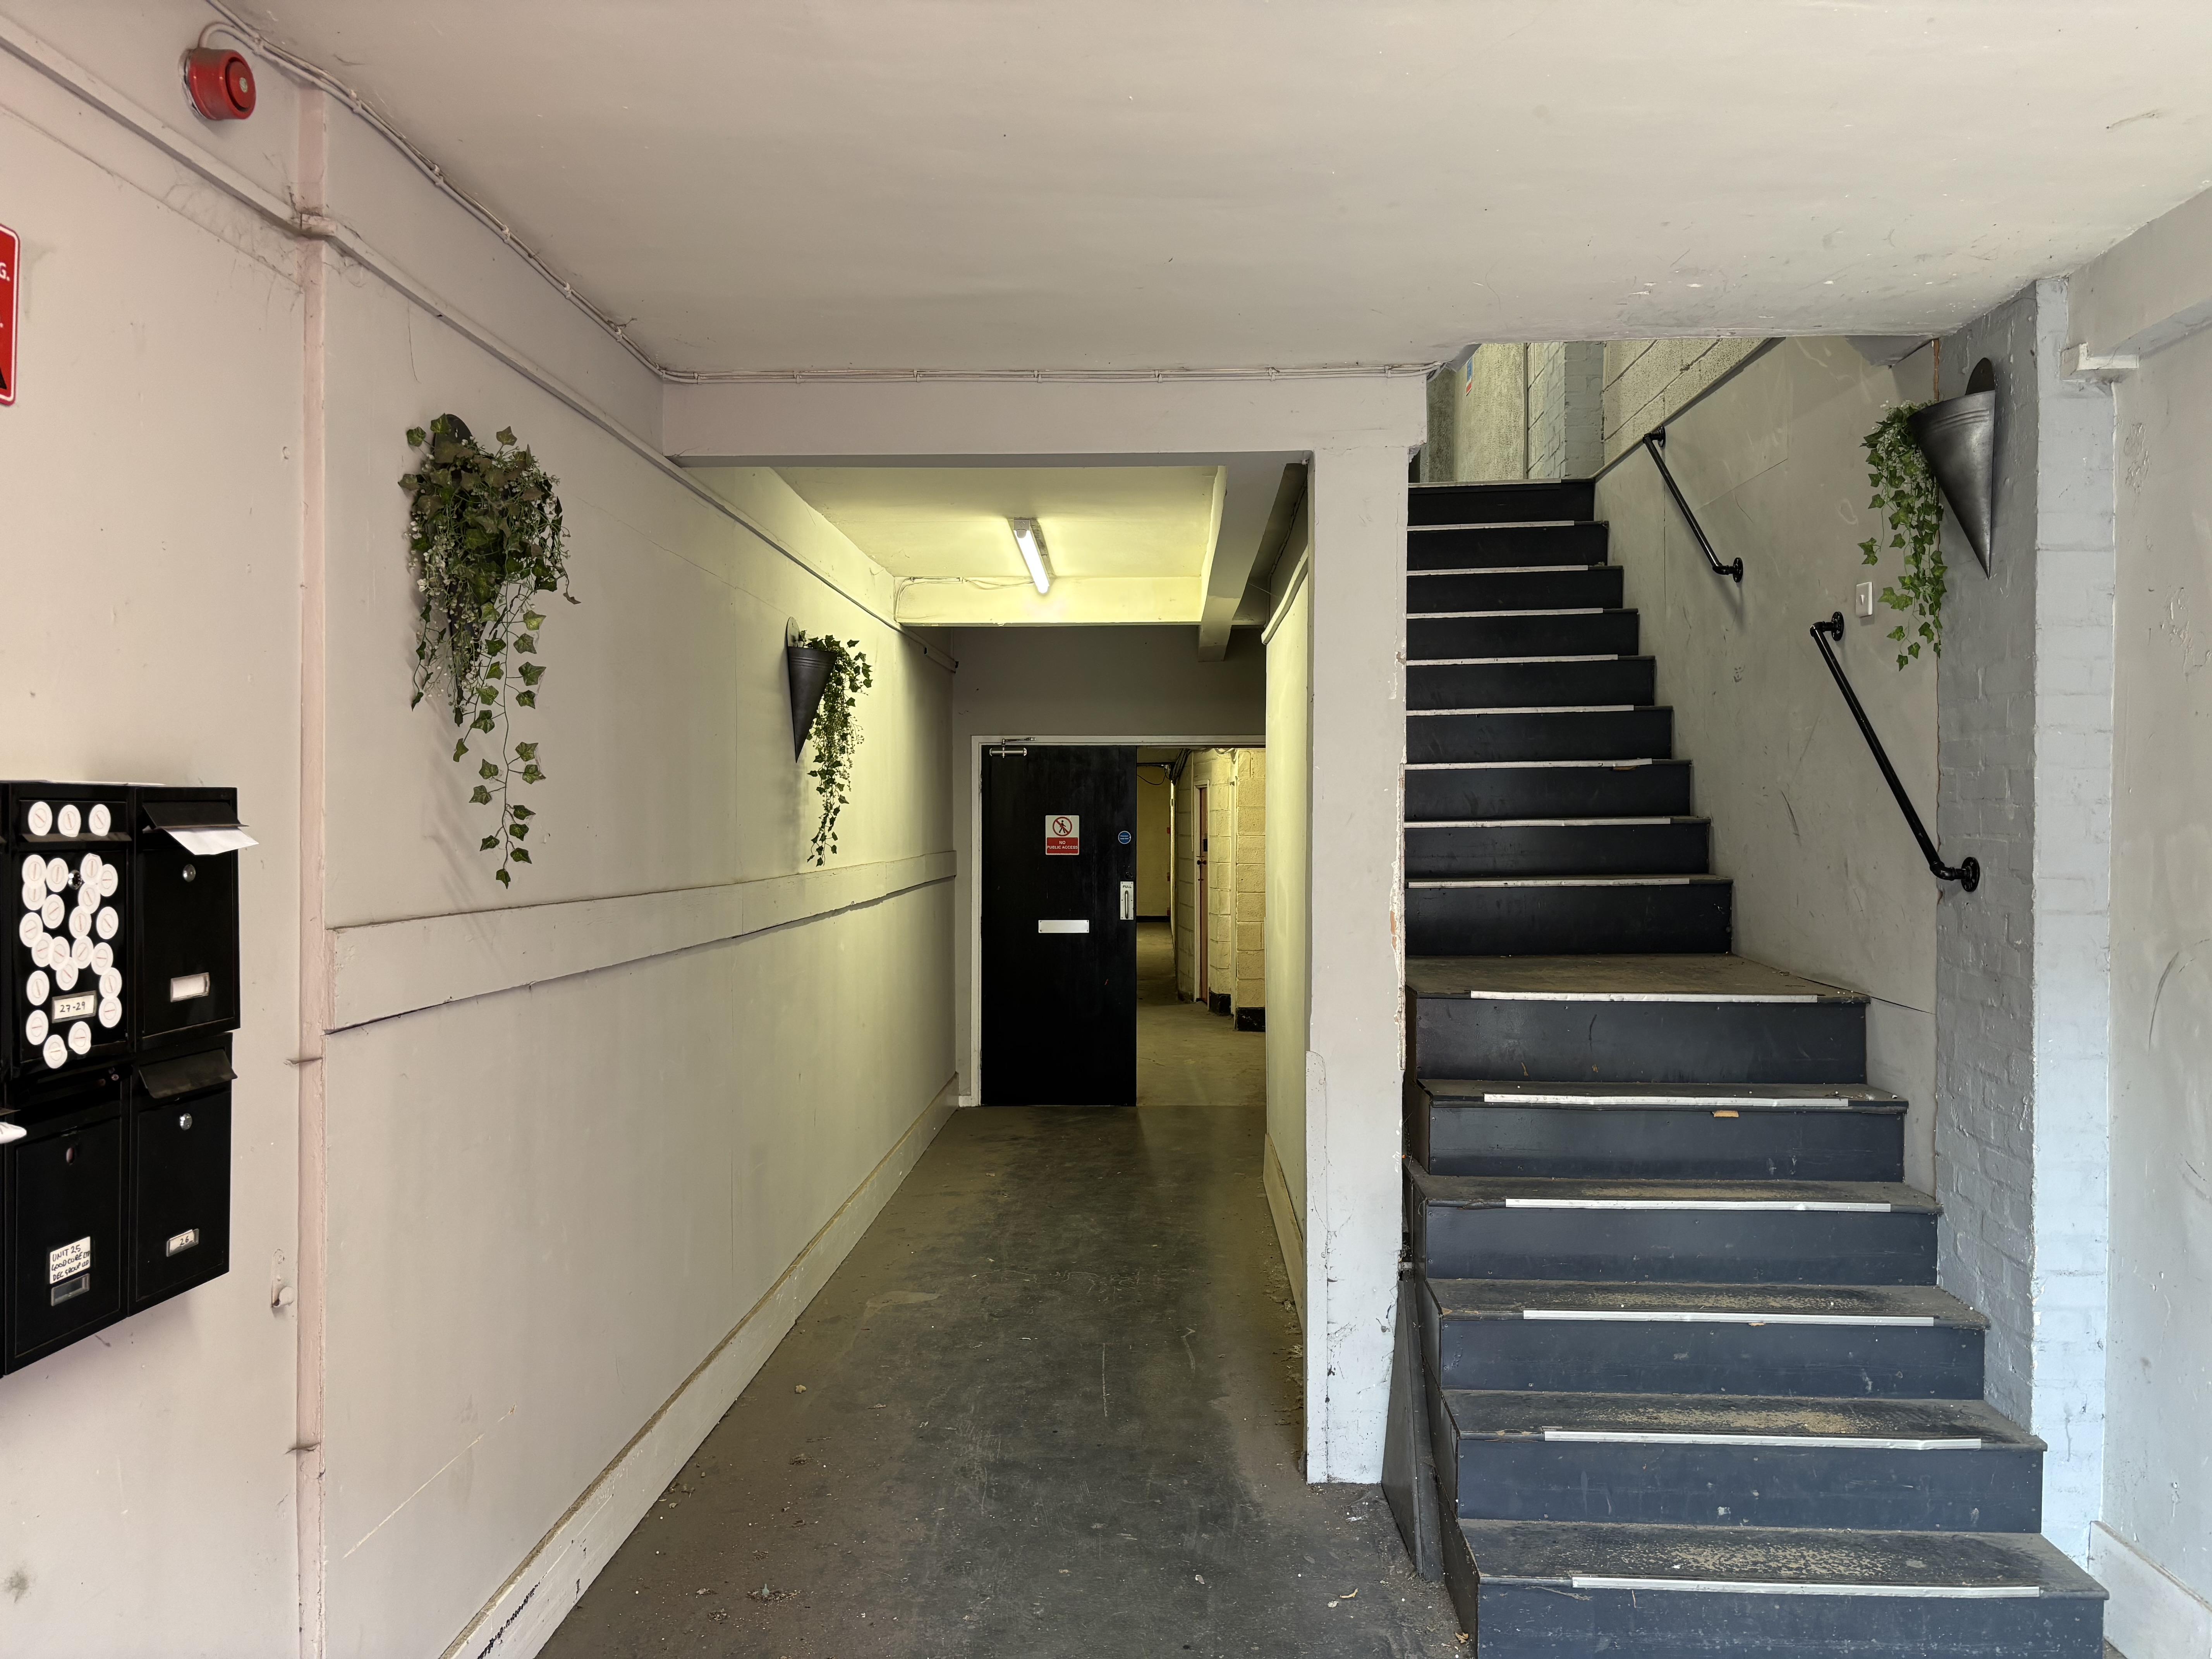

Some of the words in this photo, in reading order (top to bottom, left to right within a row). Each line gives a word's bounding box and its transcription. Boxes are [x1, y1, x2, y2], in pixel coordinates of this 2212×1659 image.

[180, 1236, 189, 1246] 26
[53, 1249, 69, 1262] UNIT
[70, 1244, 81, 1254] 25
[65, 1262, 81, 1276] GROUP
